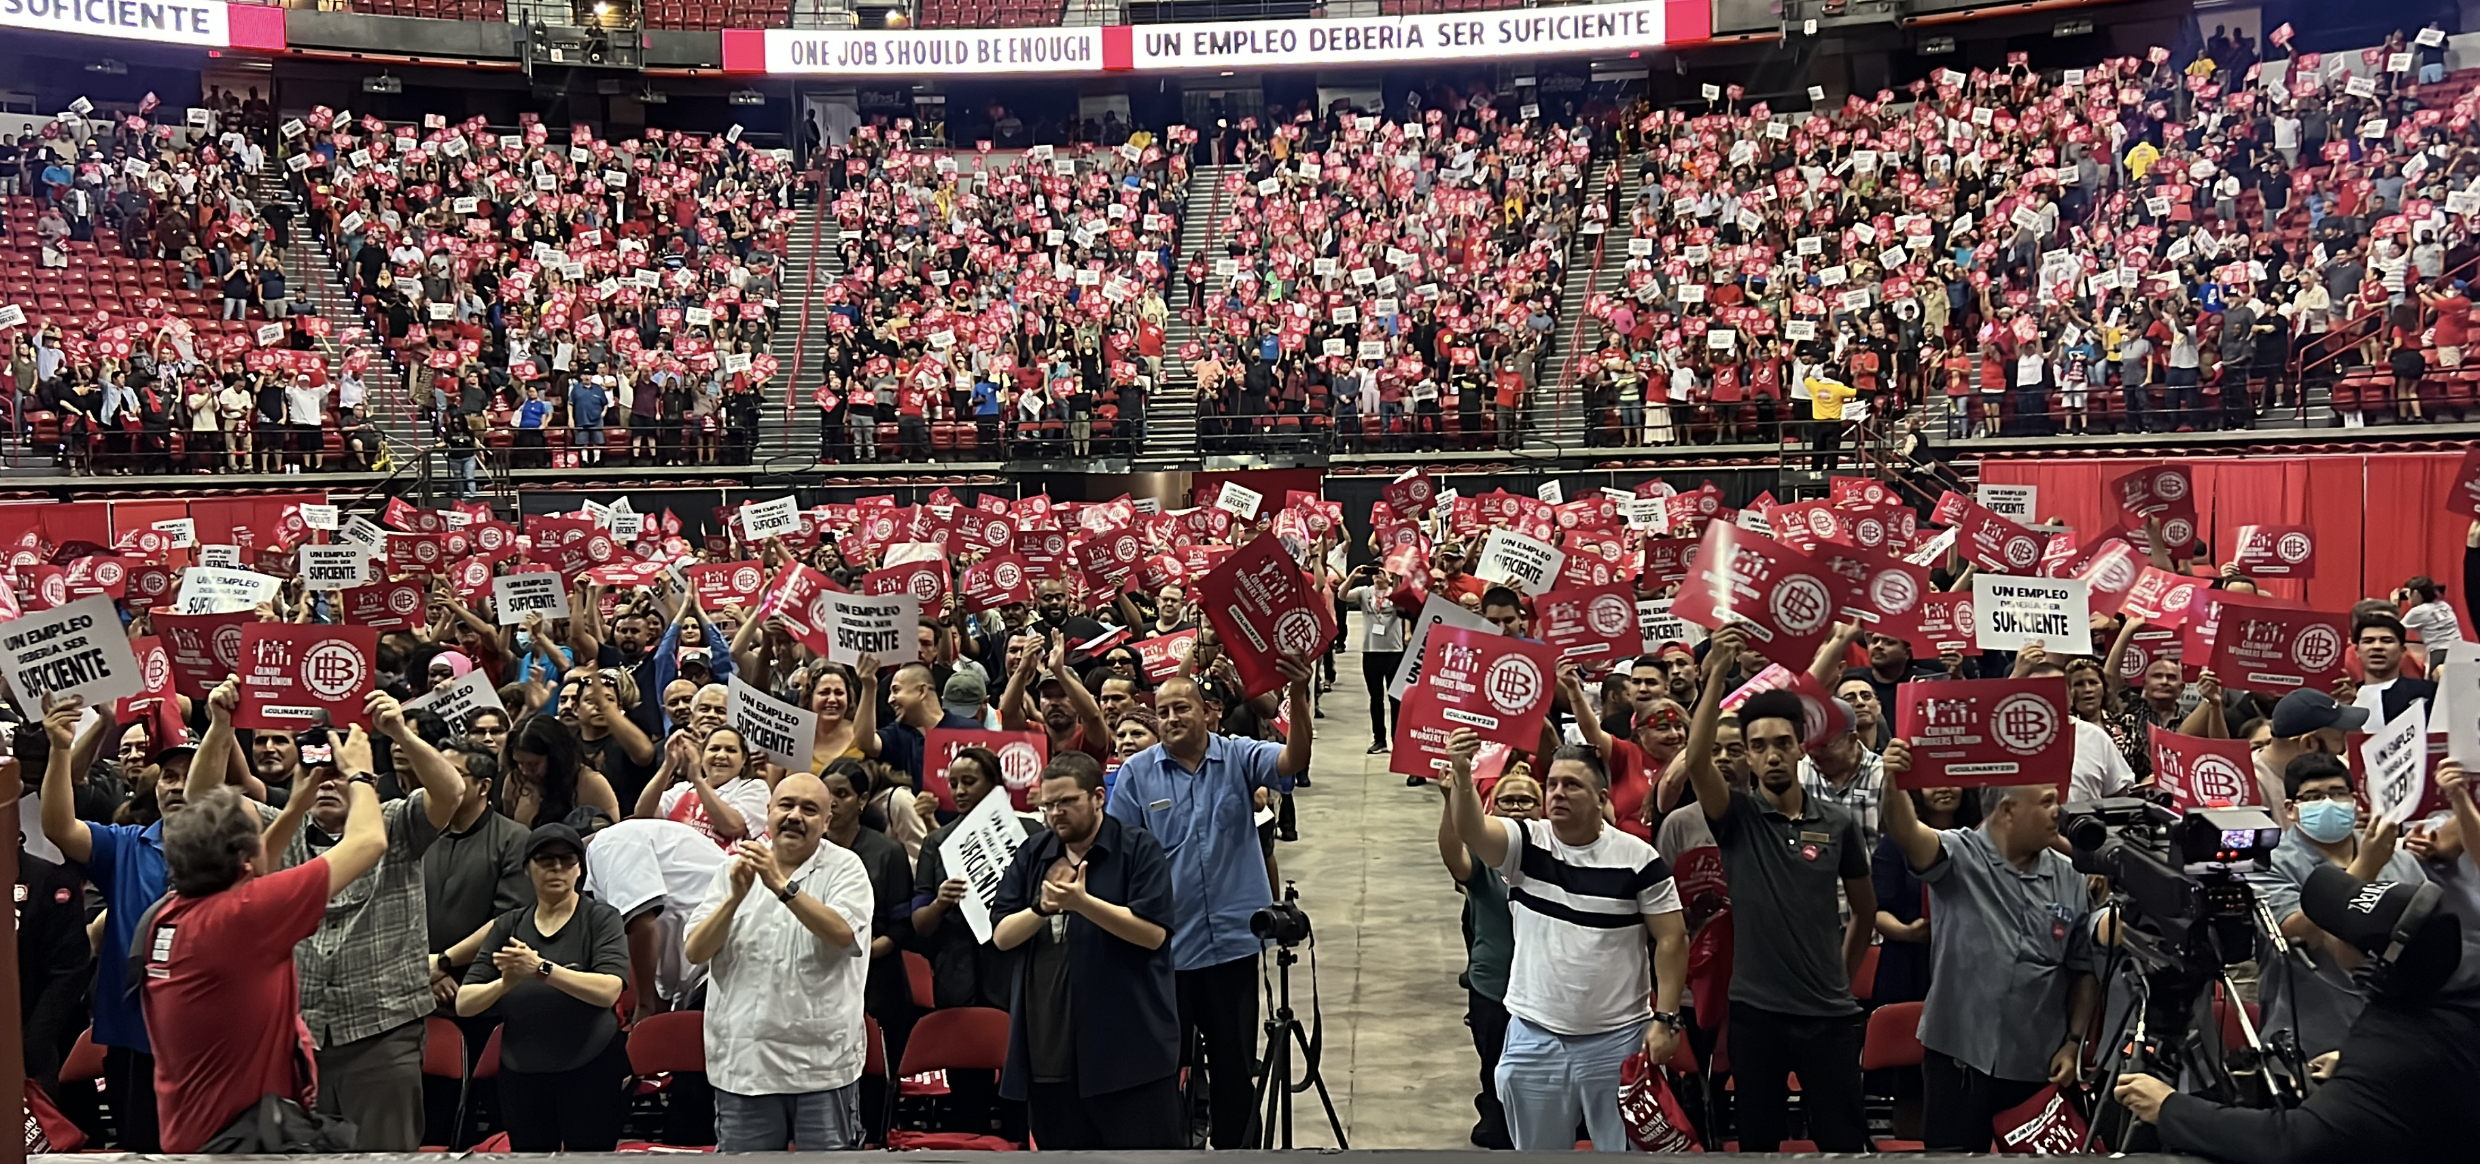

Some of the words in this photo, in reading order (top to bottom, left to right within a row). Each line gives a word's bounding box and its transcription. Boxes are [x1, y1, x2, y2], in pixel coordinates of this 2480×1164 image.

[4, 0, 210, 33] SUFICIENTE
[1146, 31, 1180, 57] UN
[1194, 29, 1296, 55] EMPLEO
[1309, 16, 1423, 52] DEBERÍA
[1437, 25, 1484, 47] SER
[1498, 11, 1650, 44] SUFICIENTE
[791, 40, 829, 66] ONE
[838, 41, 876, 66] JOB
[885, 40, 968, 65] SHOULD
[978, 39, 1002, 64] BE
[1010, 36, 1090, 62] ENOUGH
[763, 503, 788, 512] EMPLEO
[753, 515, 790, 531] SUFICIENTE
[1501, 538, 1516, 547] UN
[1517, 543, 1551, 561] EMPLEO
[309, 566, 356, 580] SUFICIENTE
[1493, 554, 1543, 585] SUFICIENTE
[217, 576, 260, 588] EMPLEO
[506, 581, 521, 589] UN
[523, 578, 552, 588] EMPLEO
[1249, 573, 1272, 601] CULINARY
[1235, 568, 1257, 598] WORKERS
[1255, 593, 1273, 617] UNION
[1992, 586, 2014, 596] UN
[2017, 588, 2068, 600] EMPLEO
[509, 594, 556, 612] SUFICIENTE
[835, 603, 851, 614] UN
[852, 603, 900, 617] EMPLEO
[2043, 602, 2060, 611] SER
[1638, 608, 1651, 616] UN
[874, 618, 892, 627] SER
[1992, 611, 2068, 636] SUFICIENTE
[4, 634, 26, 651] UN
[27, 614, 93, 647] EMPLEO
[837, 626, 899, 652] SUFICIENTE
[1642, 623, 1684, 640] UFICIENTE
[62, 636, 88, 656] SER
[2228, 645, 2259, 657] WORKERS
[2261, 650, 2283, 659] UNION
[2242, 640, 2273, 650] CULINARY
[18, 647, 111, 699] SUFICIENTE
[254, 666, 281, 676] CULINARY
[1440, 668, 1467, 682] CULINARY
[246, 675, 270, 685] WORKERS
[271, 676, 293, 686] UNION
[1430, 675, 1455, 689] WORKERS
[1455, 681, 1477, 694] UNION
[428, 685, 474, 711] EMPLEO
[455, 699, 472, 711] SER
[739, 690, 755, 708] UN
[755, 701, 799, 726] EMPLEO
[737, 712, 795, 757] SUFICIENTE
[773, 720, 790, 734] SER
[1925, 726, 1966, 736] CULINARY
[1410, 729, 1441, 743] WORKERS
[1911, 735, 1952, 747] WORKERS
[1954, 735, 1982, 745] UNION
[1638, 1111, 1664, 1135] CULINAR
